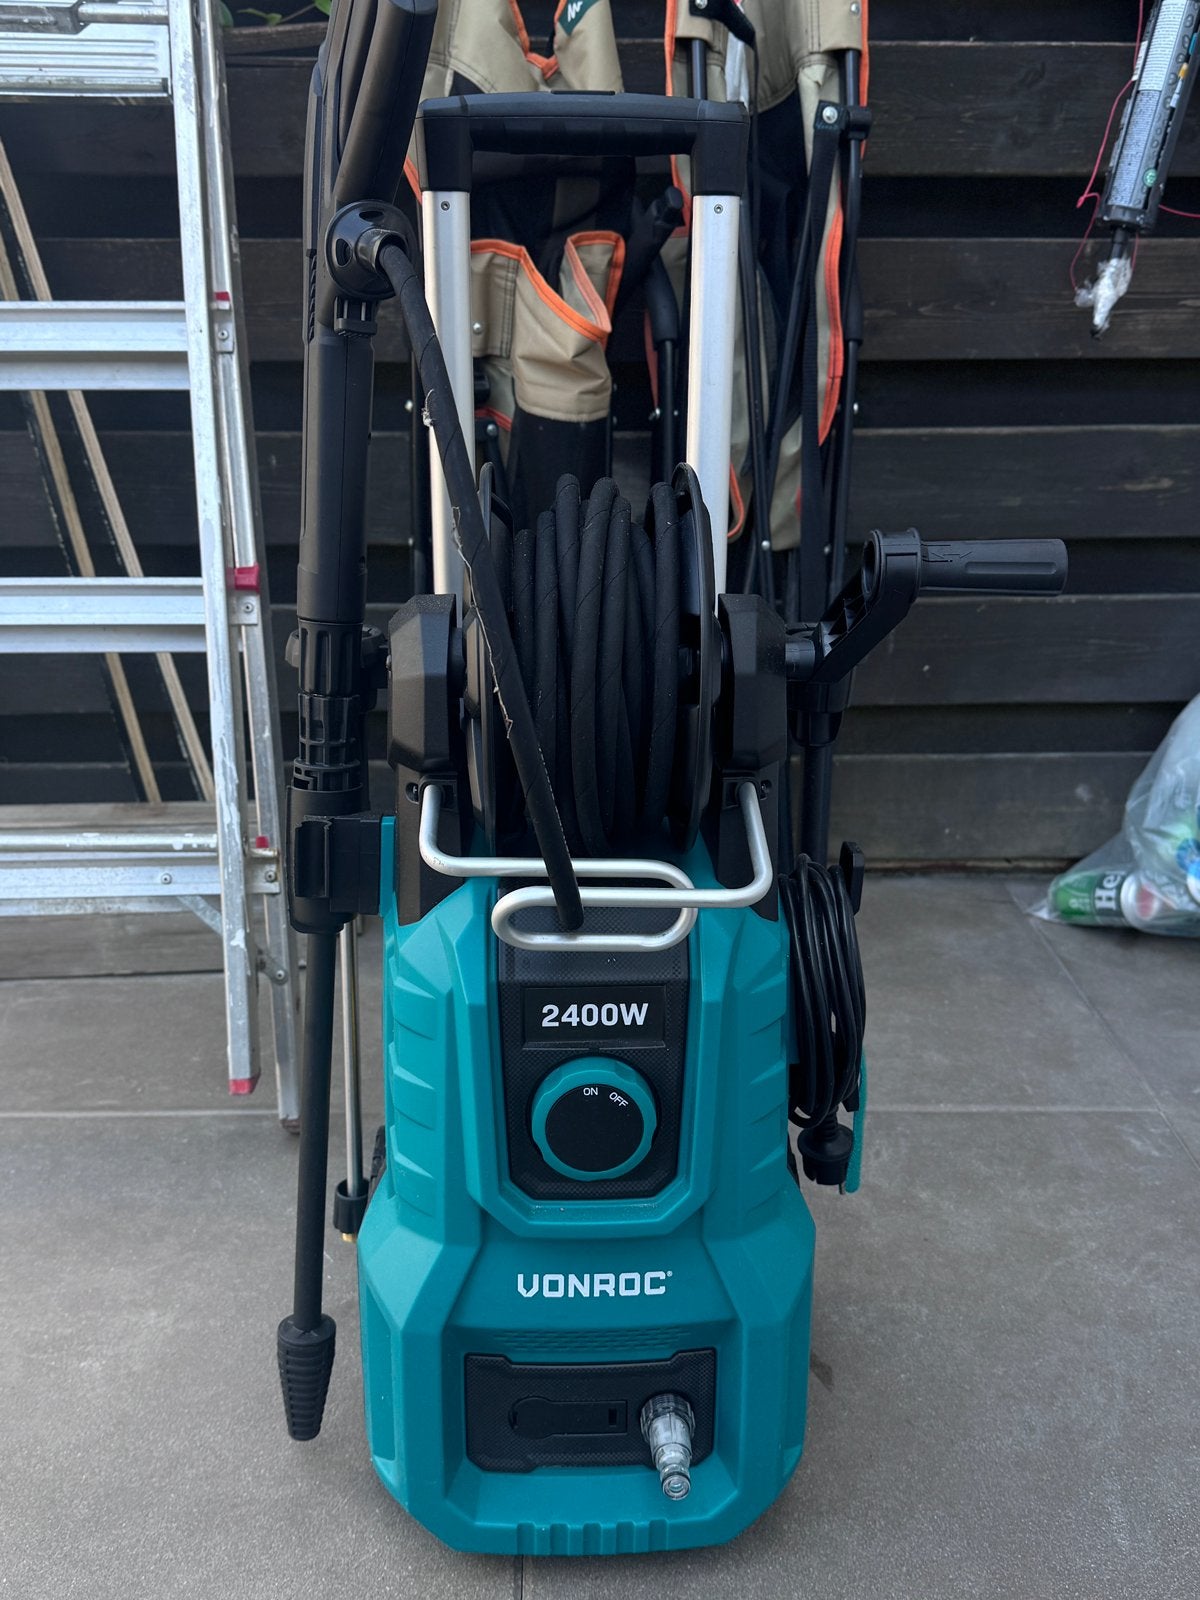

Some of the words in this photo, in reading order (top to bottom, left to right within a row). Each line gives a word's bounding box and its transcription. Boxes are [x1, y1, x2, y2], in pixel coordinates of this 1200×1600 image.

[541, 1002, 649, 1027] 2400W
[583, 1087, 599, 1096] ON
[609, 1091, 629, 1108] OFF
